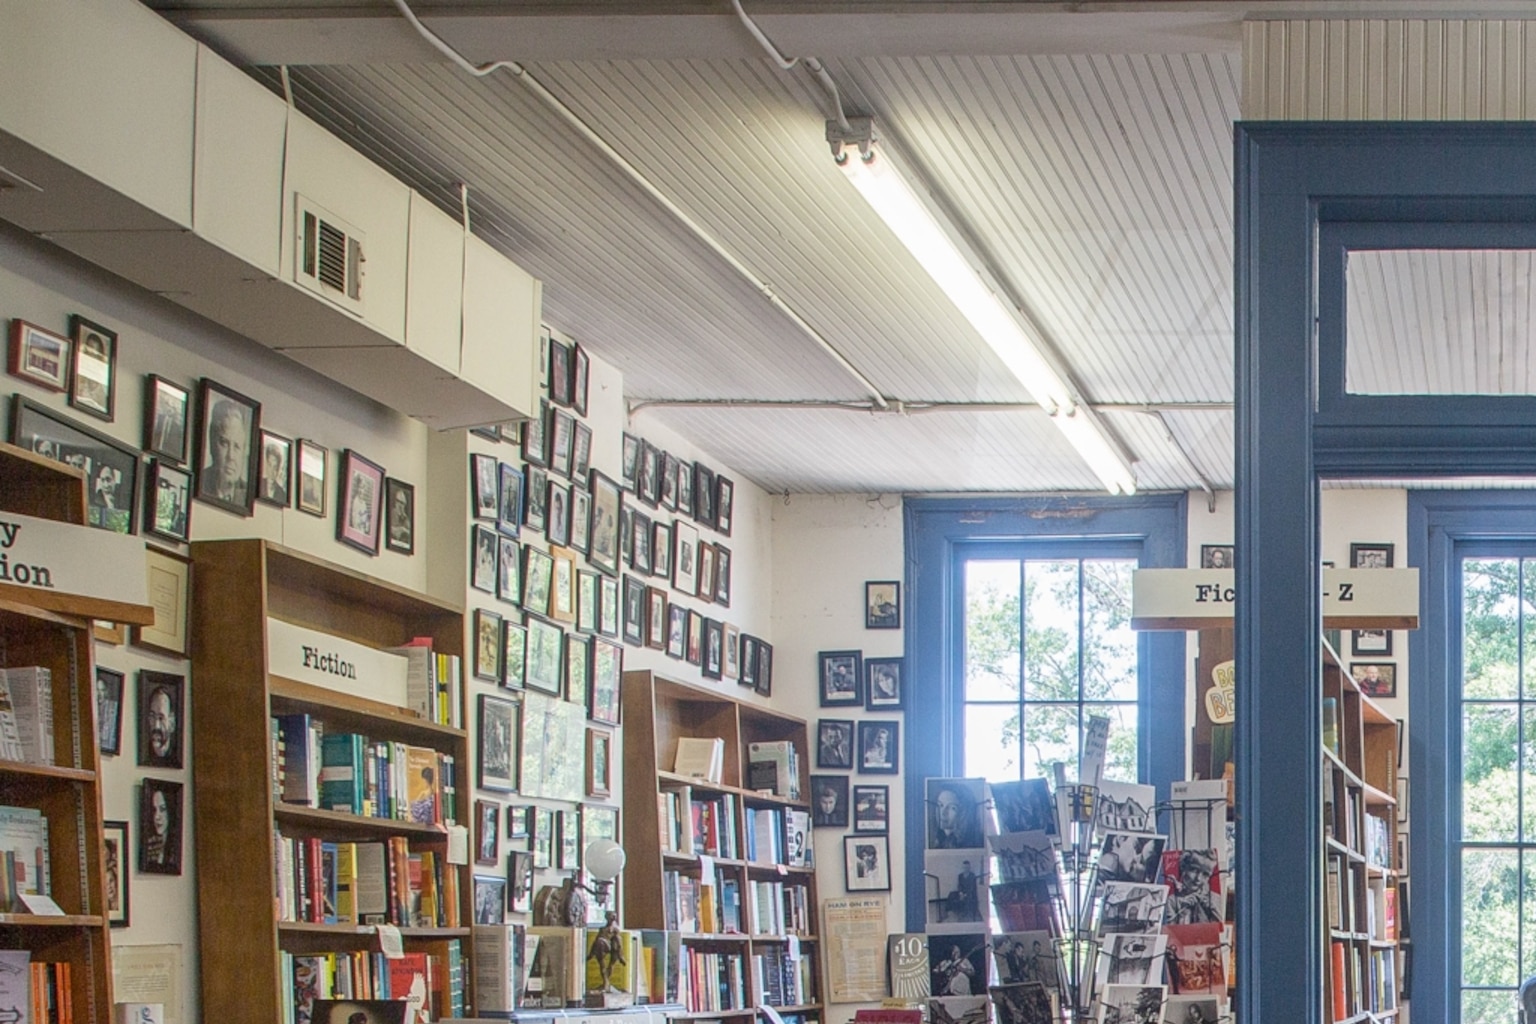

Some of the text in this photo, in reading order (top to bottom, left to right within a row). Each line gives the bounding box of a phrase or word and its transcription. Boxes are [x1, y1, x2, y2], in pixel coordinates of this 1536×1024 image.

[1195, 583, 1354, 602] Fic Z
[301, 645, 358, 682] Fiction
